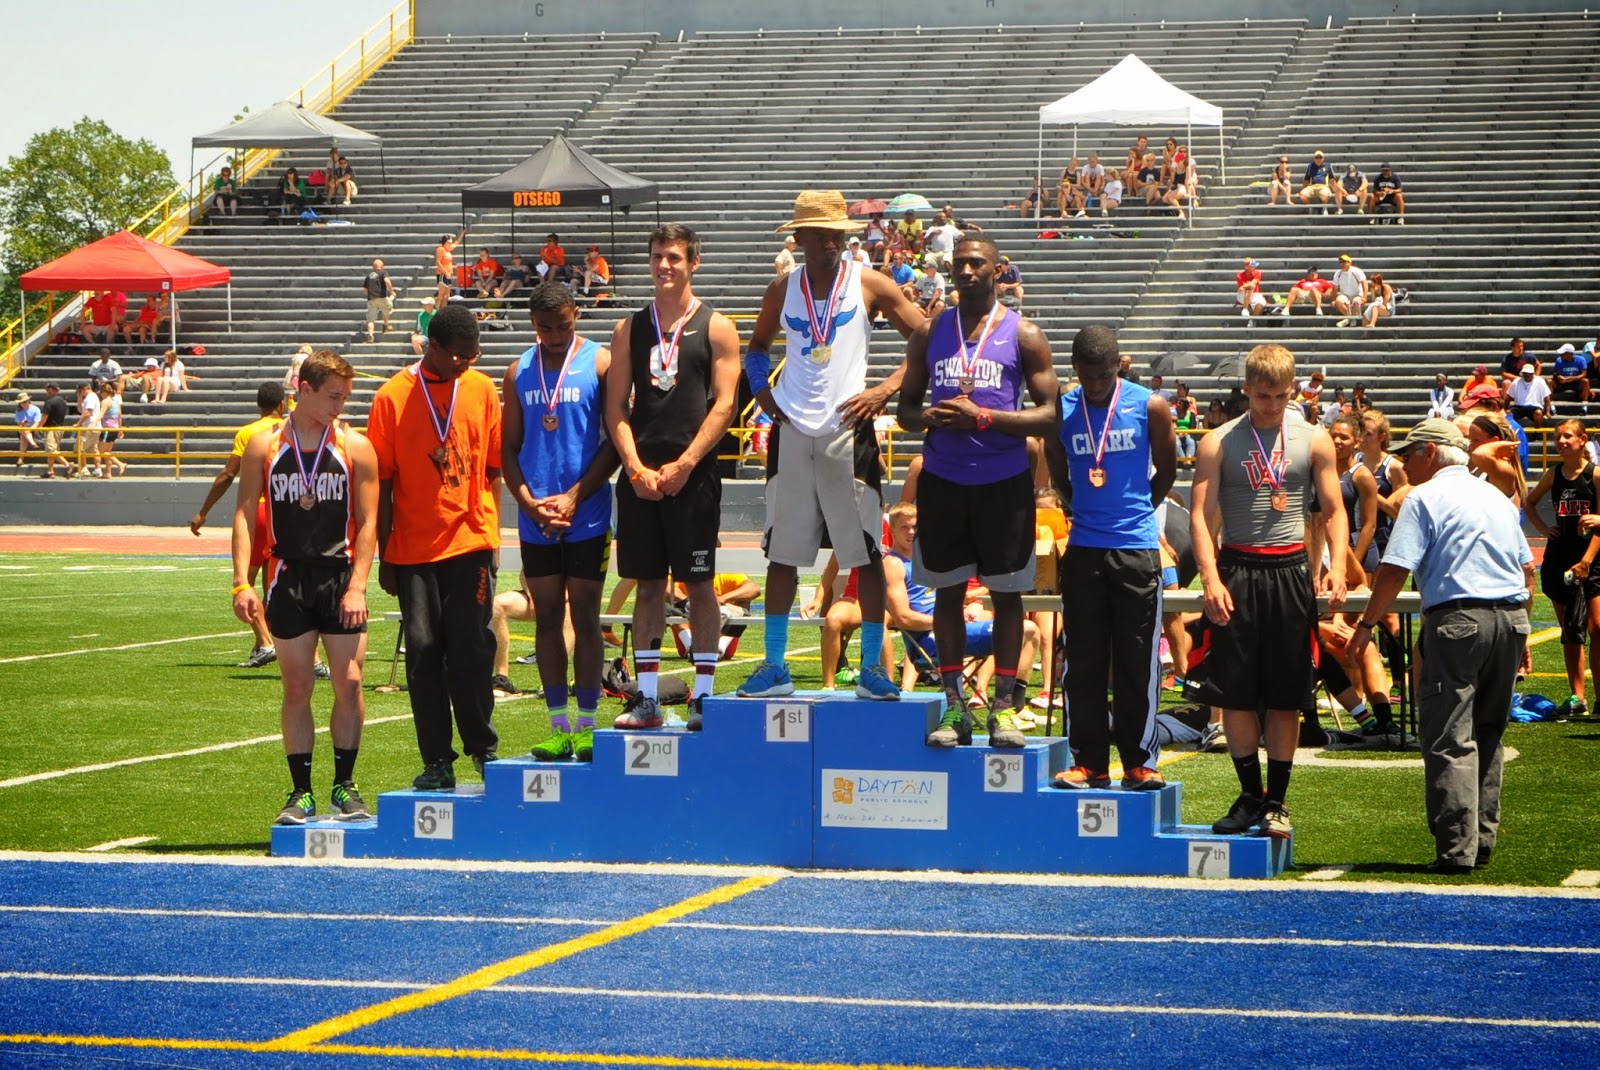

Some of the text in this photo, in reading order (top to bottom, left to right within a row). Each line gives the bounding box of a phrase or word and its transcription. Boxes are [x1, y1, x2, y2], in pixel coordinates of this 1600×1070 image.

[535, 3, 544, 17] G
[513, 191, 561, 207] OTSEGO
[525, 387, 580, 406] WYING
[1554, 500, 1591, 517] AKE
[772, 708, 803, 738] 1st
[631, 739, 672, 769] 2nd
[527, 773, 557, 799] 4th
[988, 758, 1020, 788] 3rd
[418, 805, 450, 835] 6th
[1082, 803, 1115, 833] 5th
[309, 831, 340, 859] 8th
[1192, 846, 1226, 876] 7th
